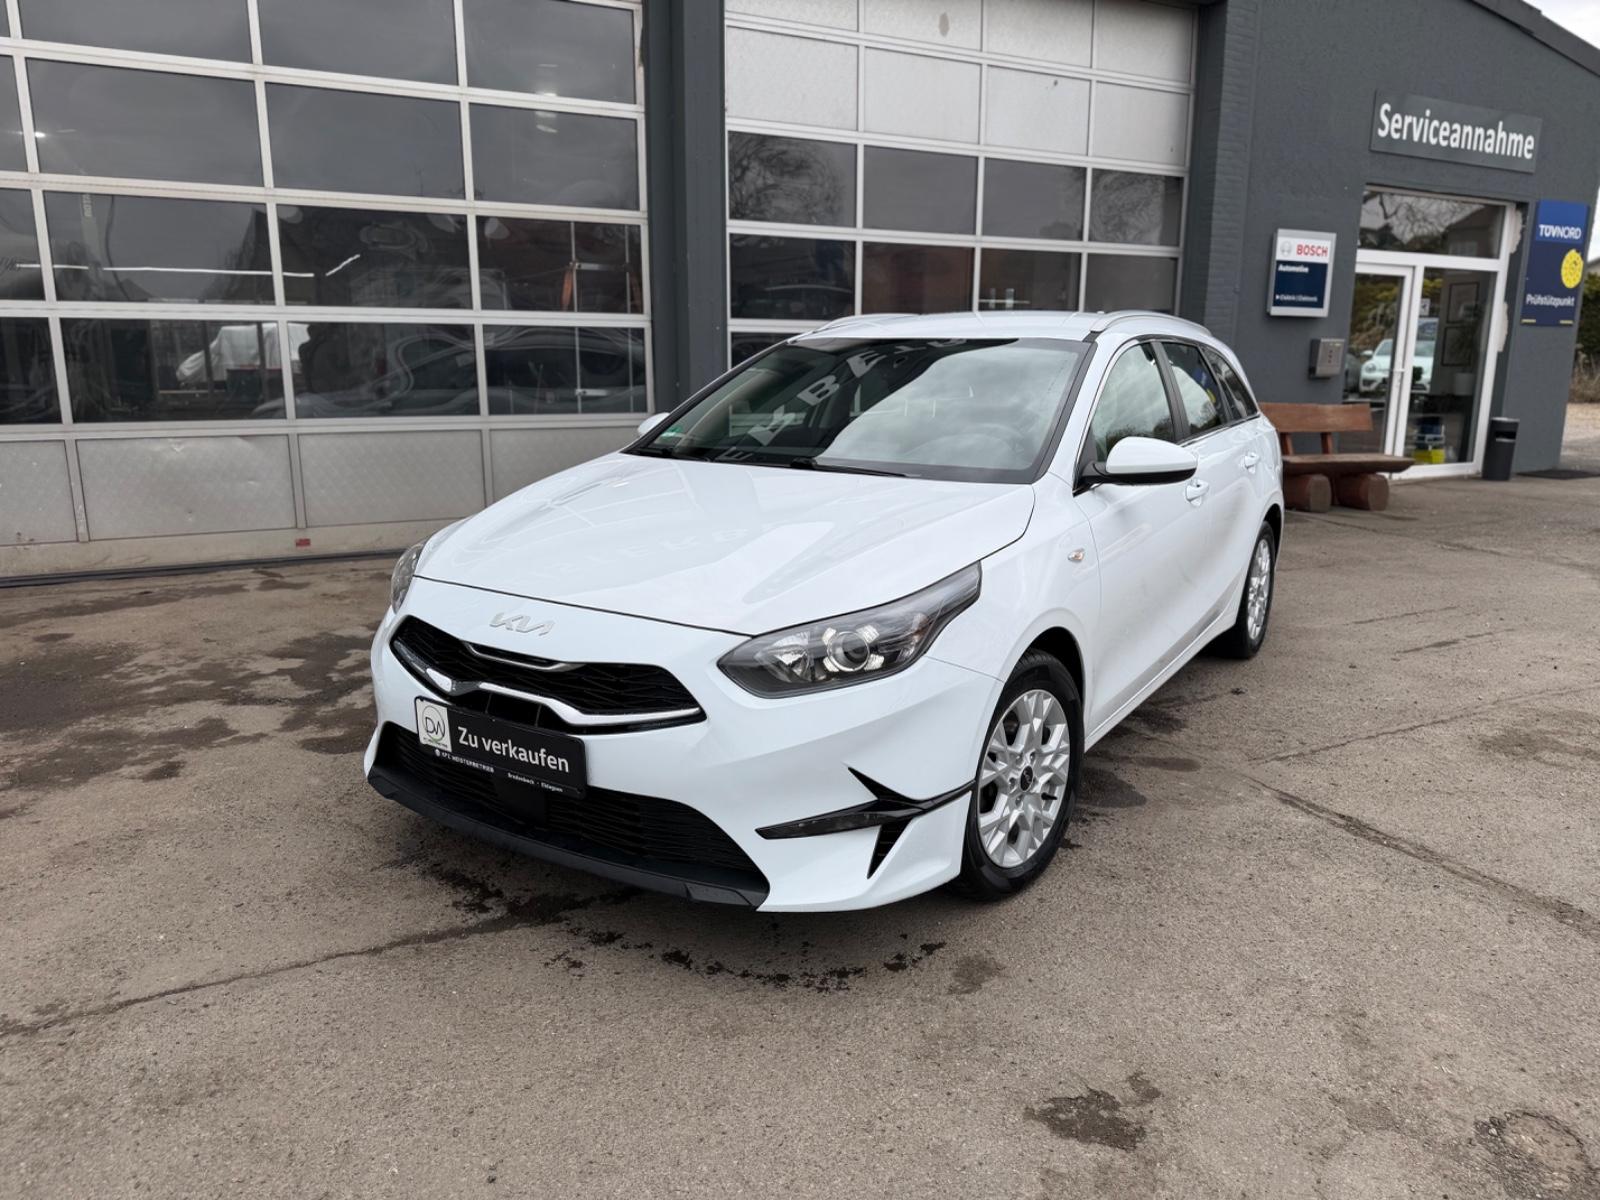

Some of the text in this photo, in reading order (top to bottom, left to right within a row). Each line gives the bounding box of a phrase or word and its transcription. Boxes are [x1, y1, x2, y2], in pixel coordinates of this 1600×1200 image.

[1377, 102, 1535, 160] Serviceannahme
[1296, 244, 1329, 257] BOSCH
[1525, 293, 1575, 309] Prüfstützpunkt
[489, 611, 555, 638] KIA
[457, 726, 478, 749] Zu
[482, 737, 570, 773] verkaufen
